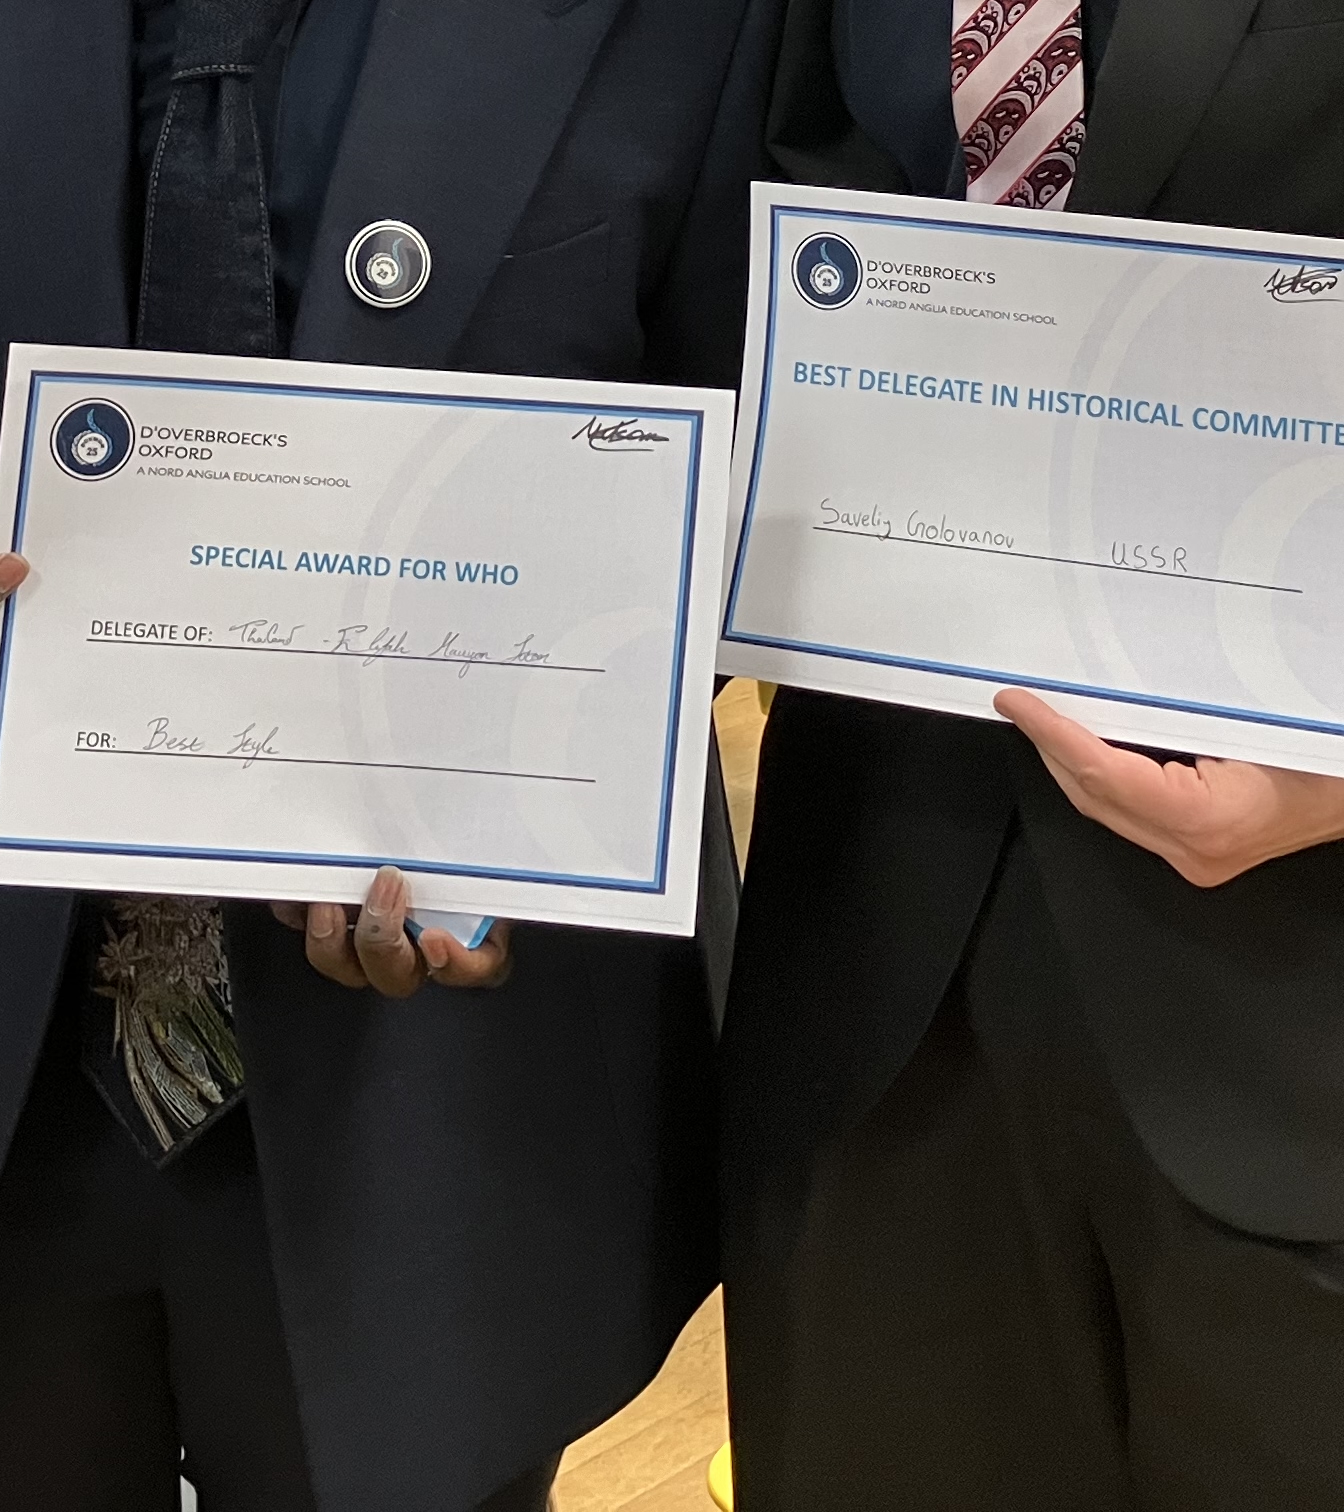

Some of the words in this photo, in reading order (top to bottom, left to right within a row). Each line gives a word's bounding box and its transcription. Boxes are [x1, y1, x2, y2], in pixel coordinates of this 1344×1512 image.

[866, 260, 997, 285] D'OVERBROECK'S
[866, 277, 931, 295] OXFORD
[866, 297, 874, 307] A
[875, 298, 907, 311] NORD
[908, 301, 949, 315] ANGLIA
[949, 306, 1011, 321] EDUCATION
[1012, 312, 1058, 326] SCHOOL
[793, 360, 853, 389] BEST
[858, 368, 984, 405] DELEGATE
[991, 383, 1019, 408] IN
[1027, 387, 1184, 428] HISTORICAL
[140, 425, 288, 448] D'OVERBROECK'S
[138, 444, 213, 461] OXFORD
[136, 467, 146, 476] A
[148, 467, 184, 478] NORD
[186, 468, 231, 481] ANGLIA
[233, 472, 301, 486] EDUCATION
[302, 475, 352, 489] SCHOOL
[189, 544, 289, 572] SPECIAL
[294, 551, 392, 577] AWARD
[399, 557, 447, 582] FOR
[455, 561, 520, 586] WHO
[1111, 541, 1188, 573] USSR
[91, 619, 179, 640] DELEGATE
[183, 625, 213, 642] OF:
[76, 731, 117, 749] FOR:
[143, 716, 206, 751] Best
